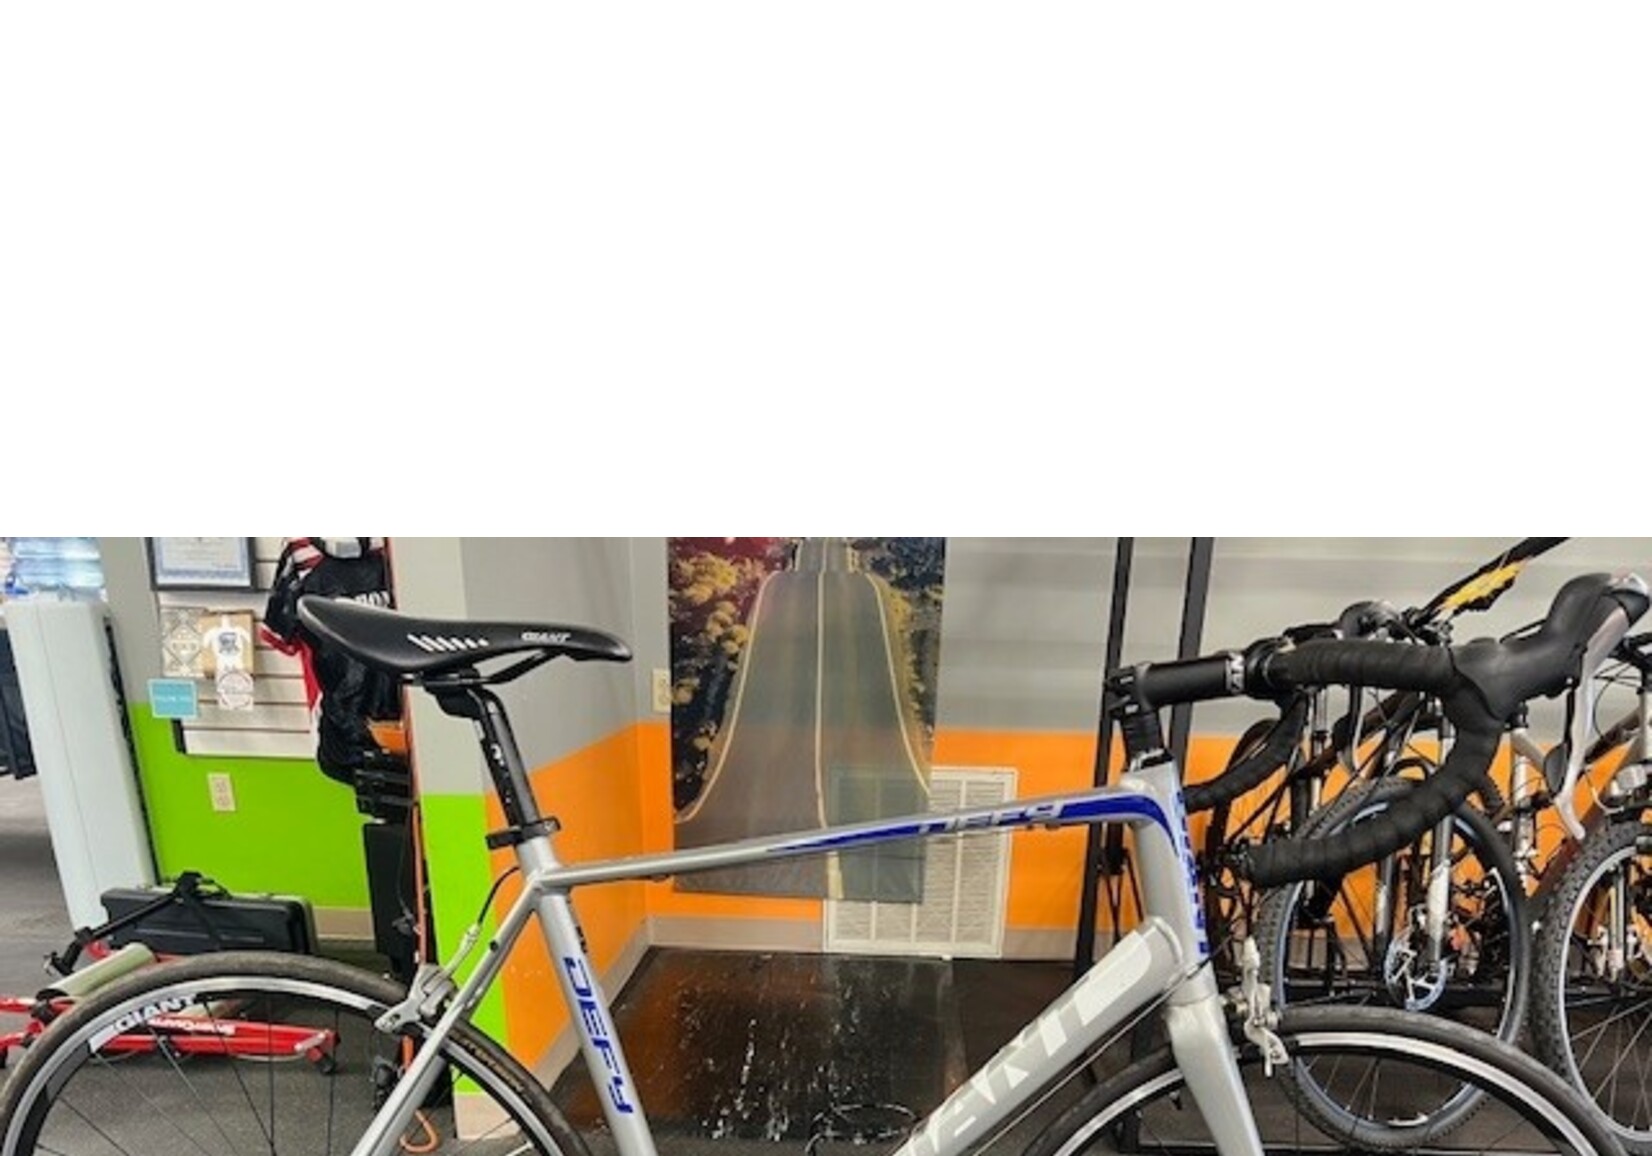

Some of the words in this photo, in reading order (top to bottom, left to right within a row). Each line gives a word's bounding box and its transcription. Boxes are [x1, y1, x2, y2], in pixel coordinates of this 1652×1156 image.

[521, 631, 572, 644] GIANT
[115, 993, 198, 1032] GIANT
[563, 956, 634, 1114] DEFY
